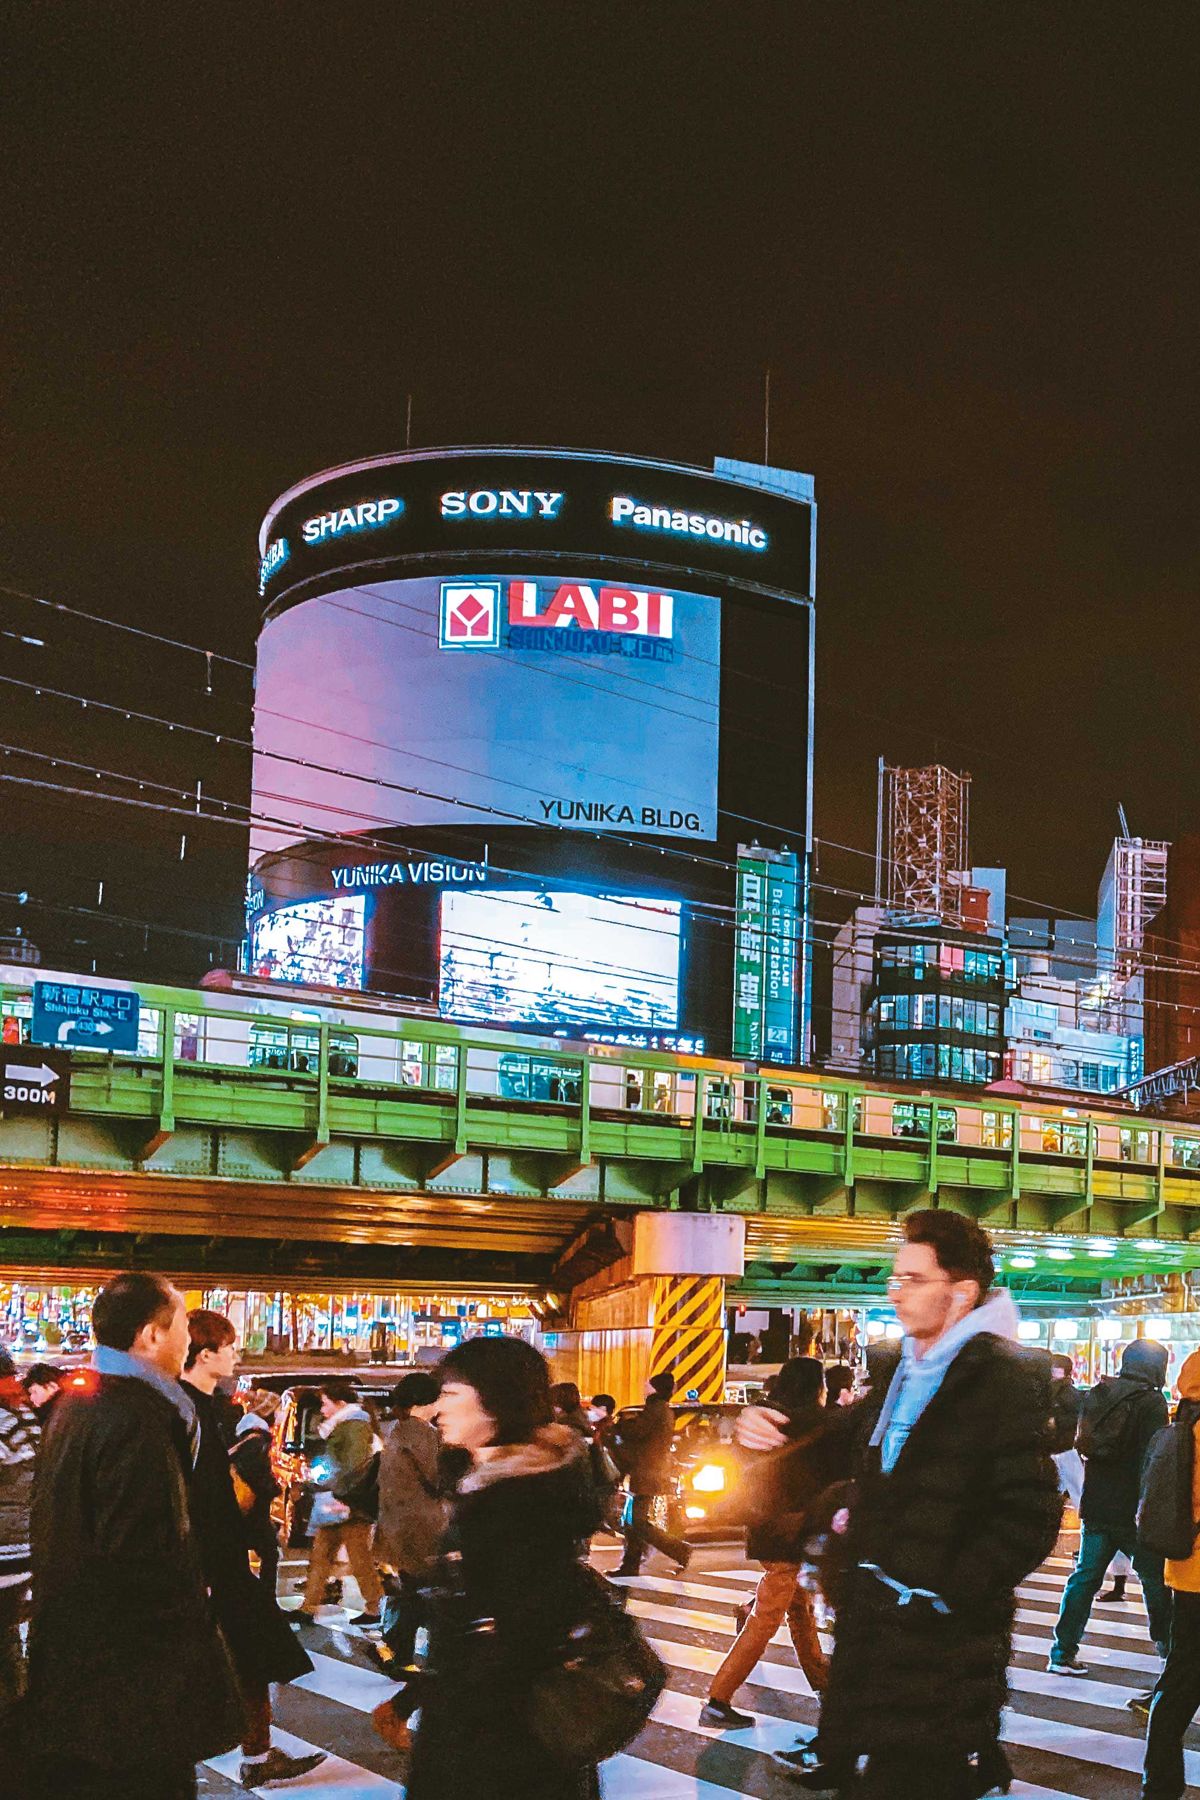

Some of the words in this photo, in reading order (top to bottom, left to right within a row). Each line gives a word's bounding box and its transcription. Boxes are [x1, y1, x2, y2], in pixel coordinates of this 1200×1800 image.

[441, 490, 562, 516] SONY
[302, 499, 400, 541] SHARP
[612, 496, 767, 548] Panasonic
[509, 582, 673, 638] LABI
[540, 800, 635, 824] YUNIKA
[640, 807, 705, 833] BLDG.
[332, 864, 402, 889] YUNIKA
[409, 860, 486, 882] VISION
[770, 945, 782, 998] station
[45, 1002, 89, 1015] Shinjuku
[4, 1086, 56, 1104] 300M
